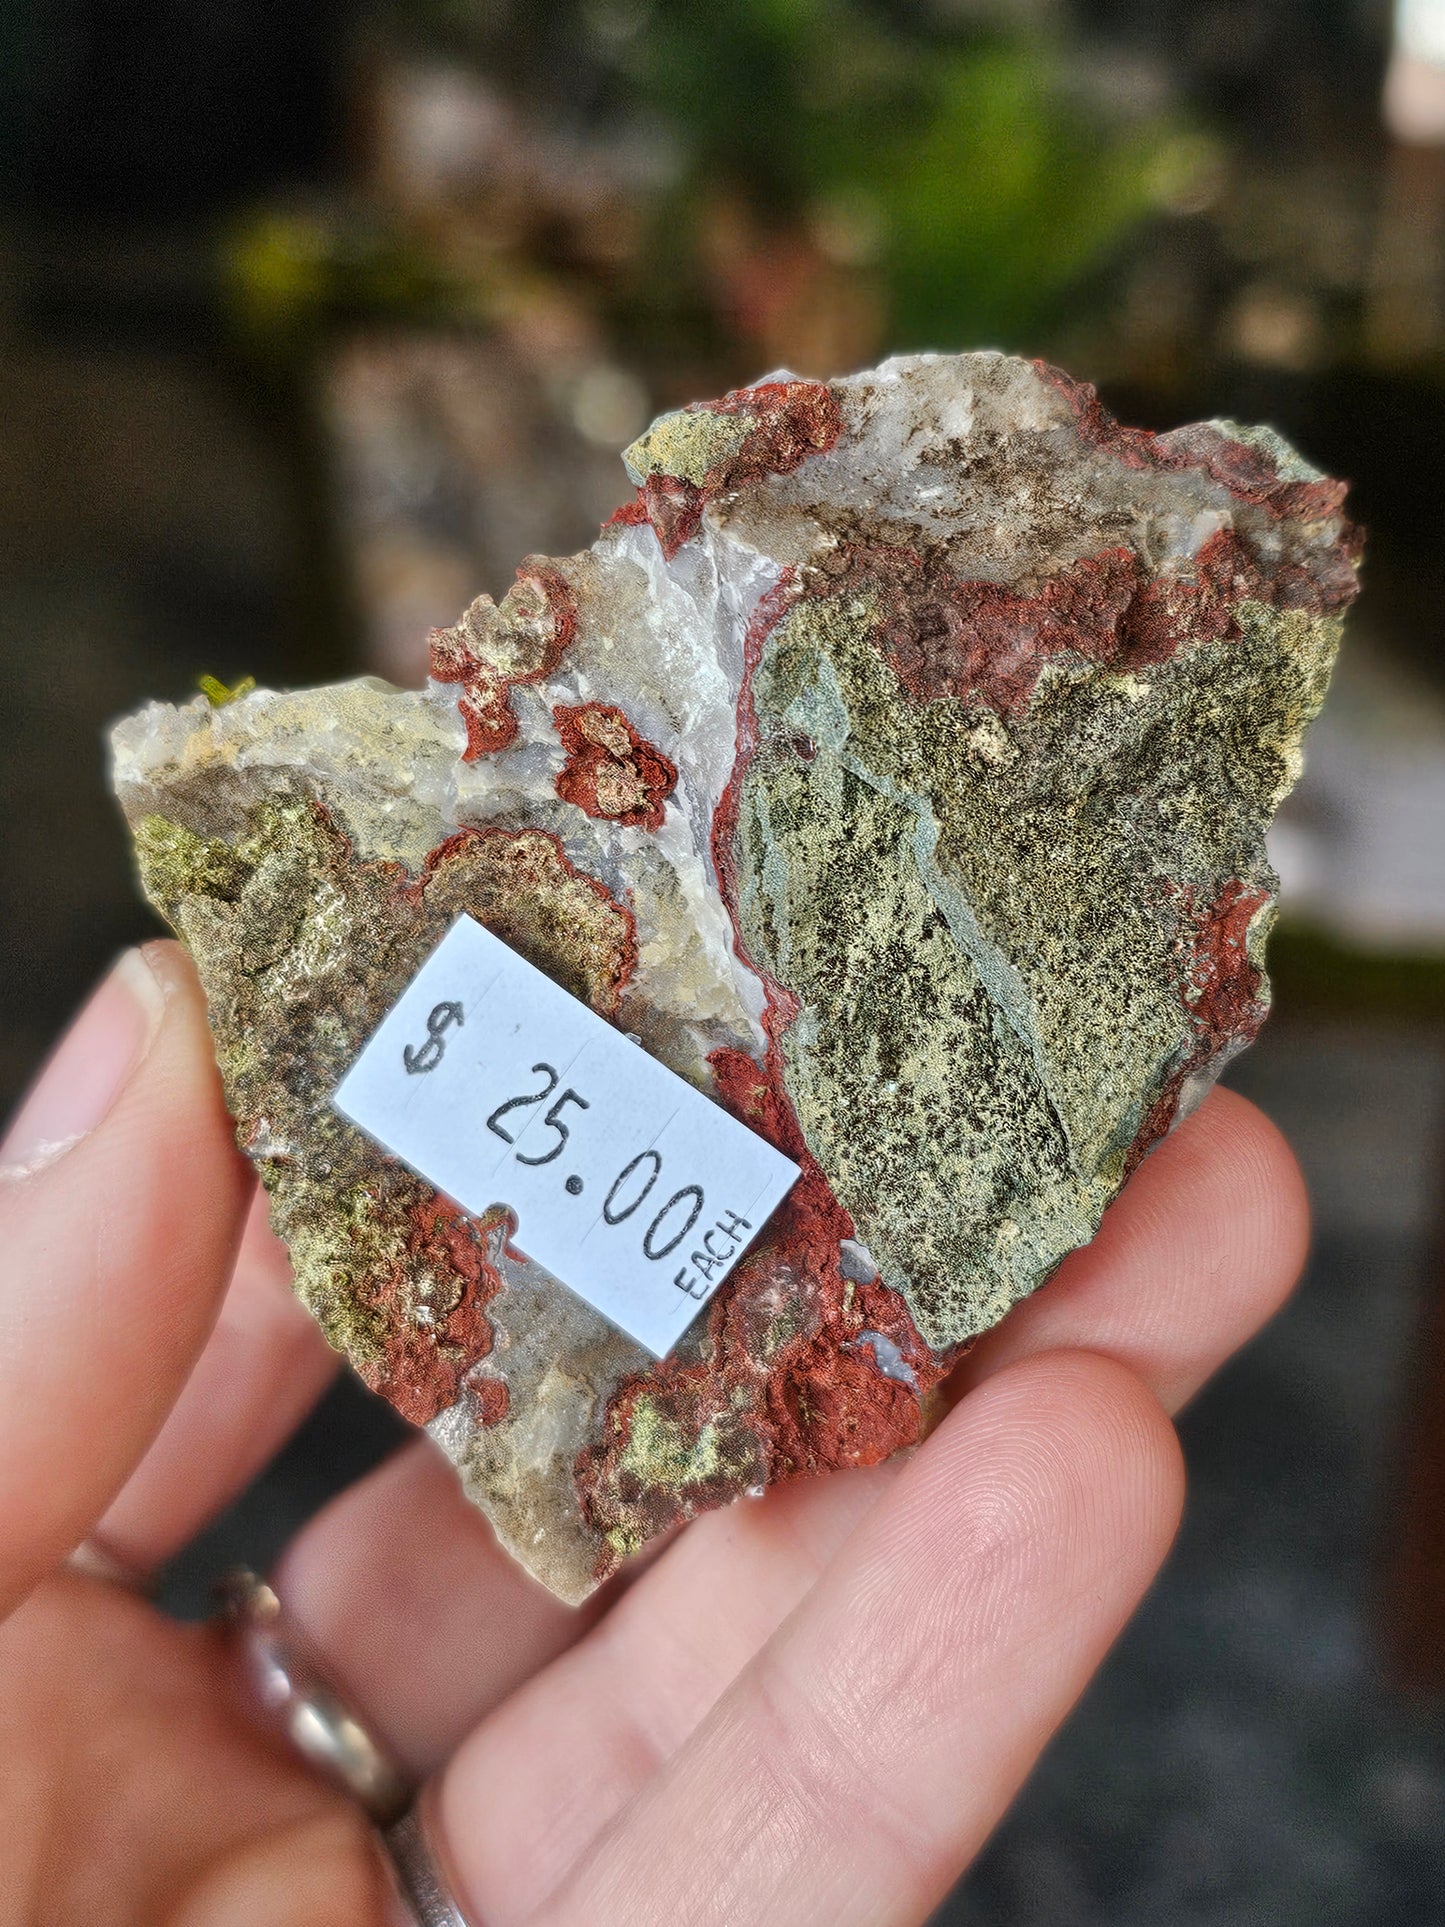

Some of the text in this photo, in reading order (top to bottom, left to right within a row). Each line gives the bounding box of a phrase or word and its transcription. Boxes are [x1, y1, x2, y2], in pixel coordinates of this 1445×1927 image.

[403, 1001, 705, 1261] $ 25.00
[673, 1209, 753, 1301] EACH
